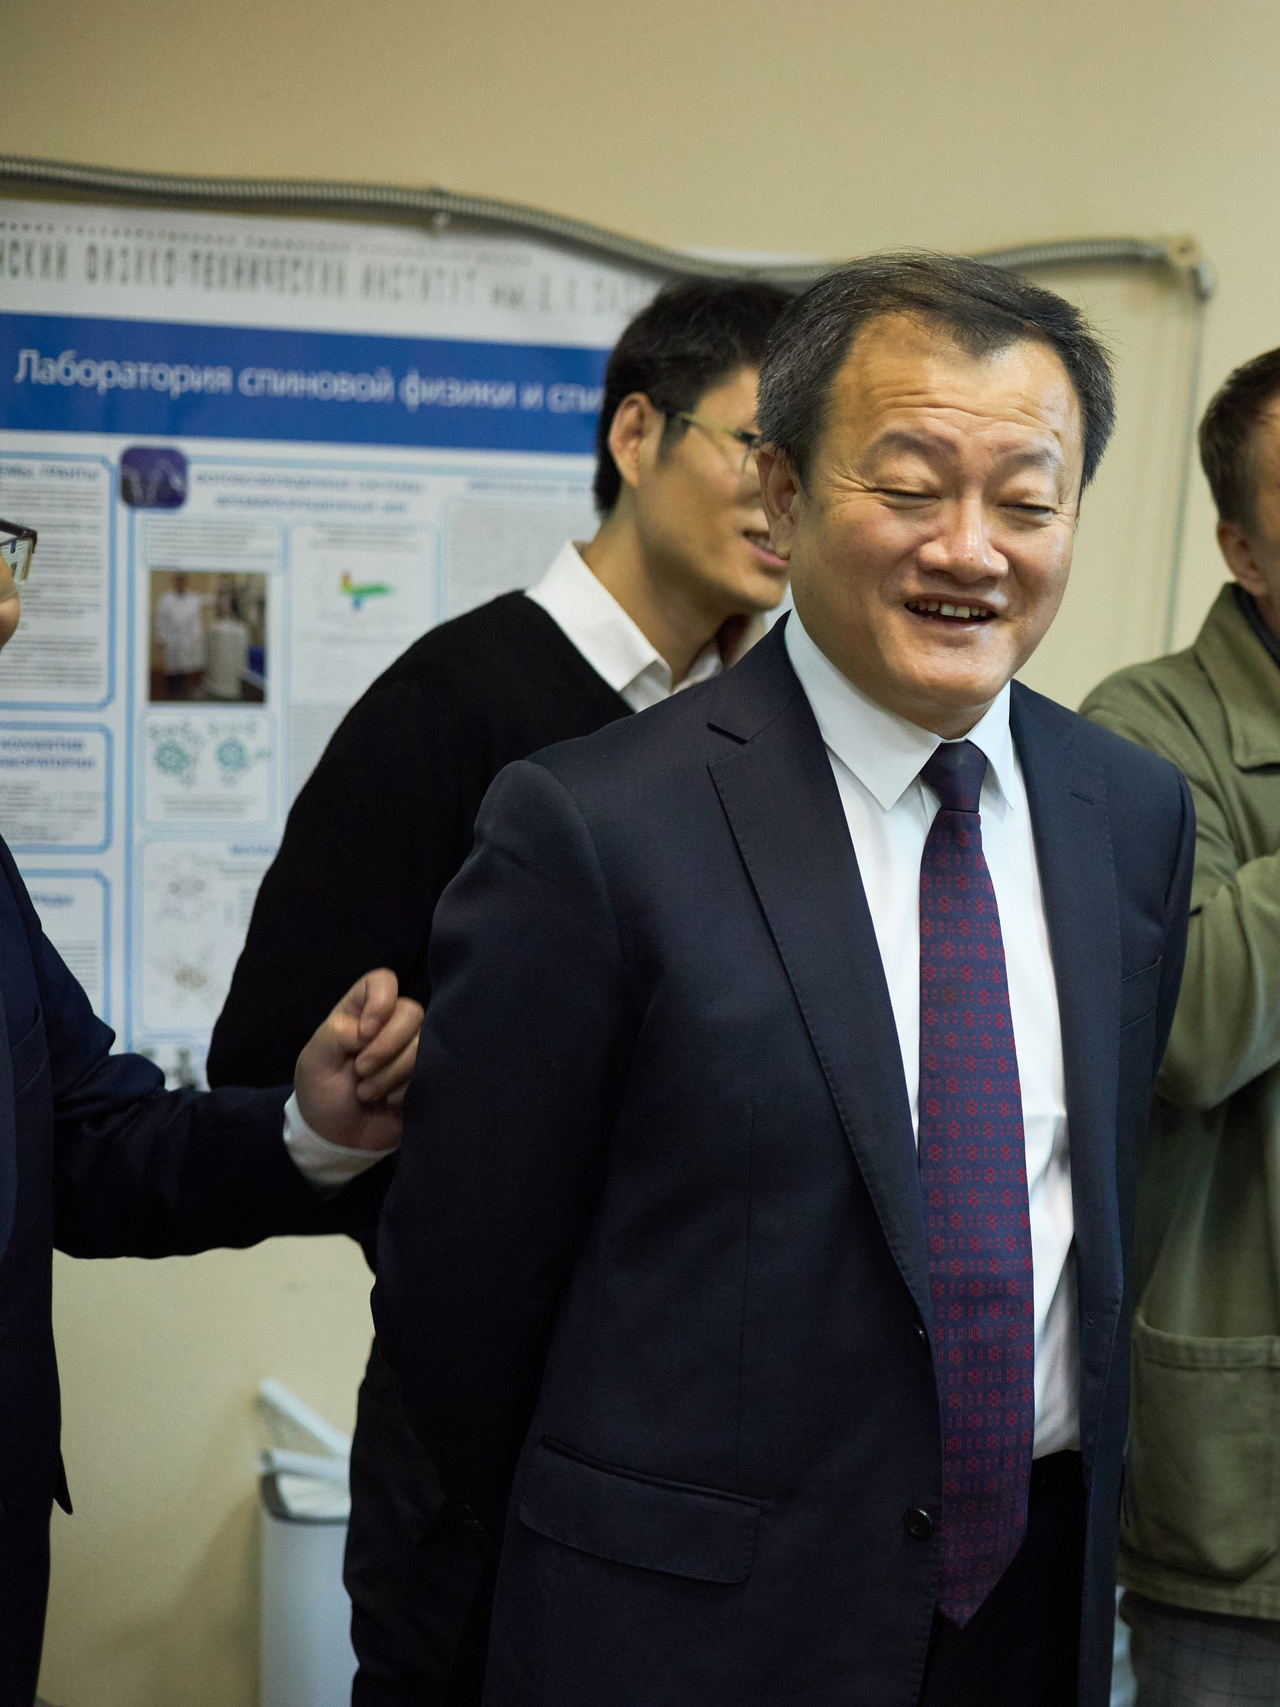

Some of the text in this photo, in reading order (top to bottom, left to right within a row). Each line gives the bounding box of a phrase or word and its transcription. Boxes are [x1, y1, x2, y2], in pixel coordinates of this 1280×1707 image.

[13, 349, 604, 414] Лаборатория спиновой физики и спи
